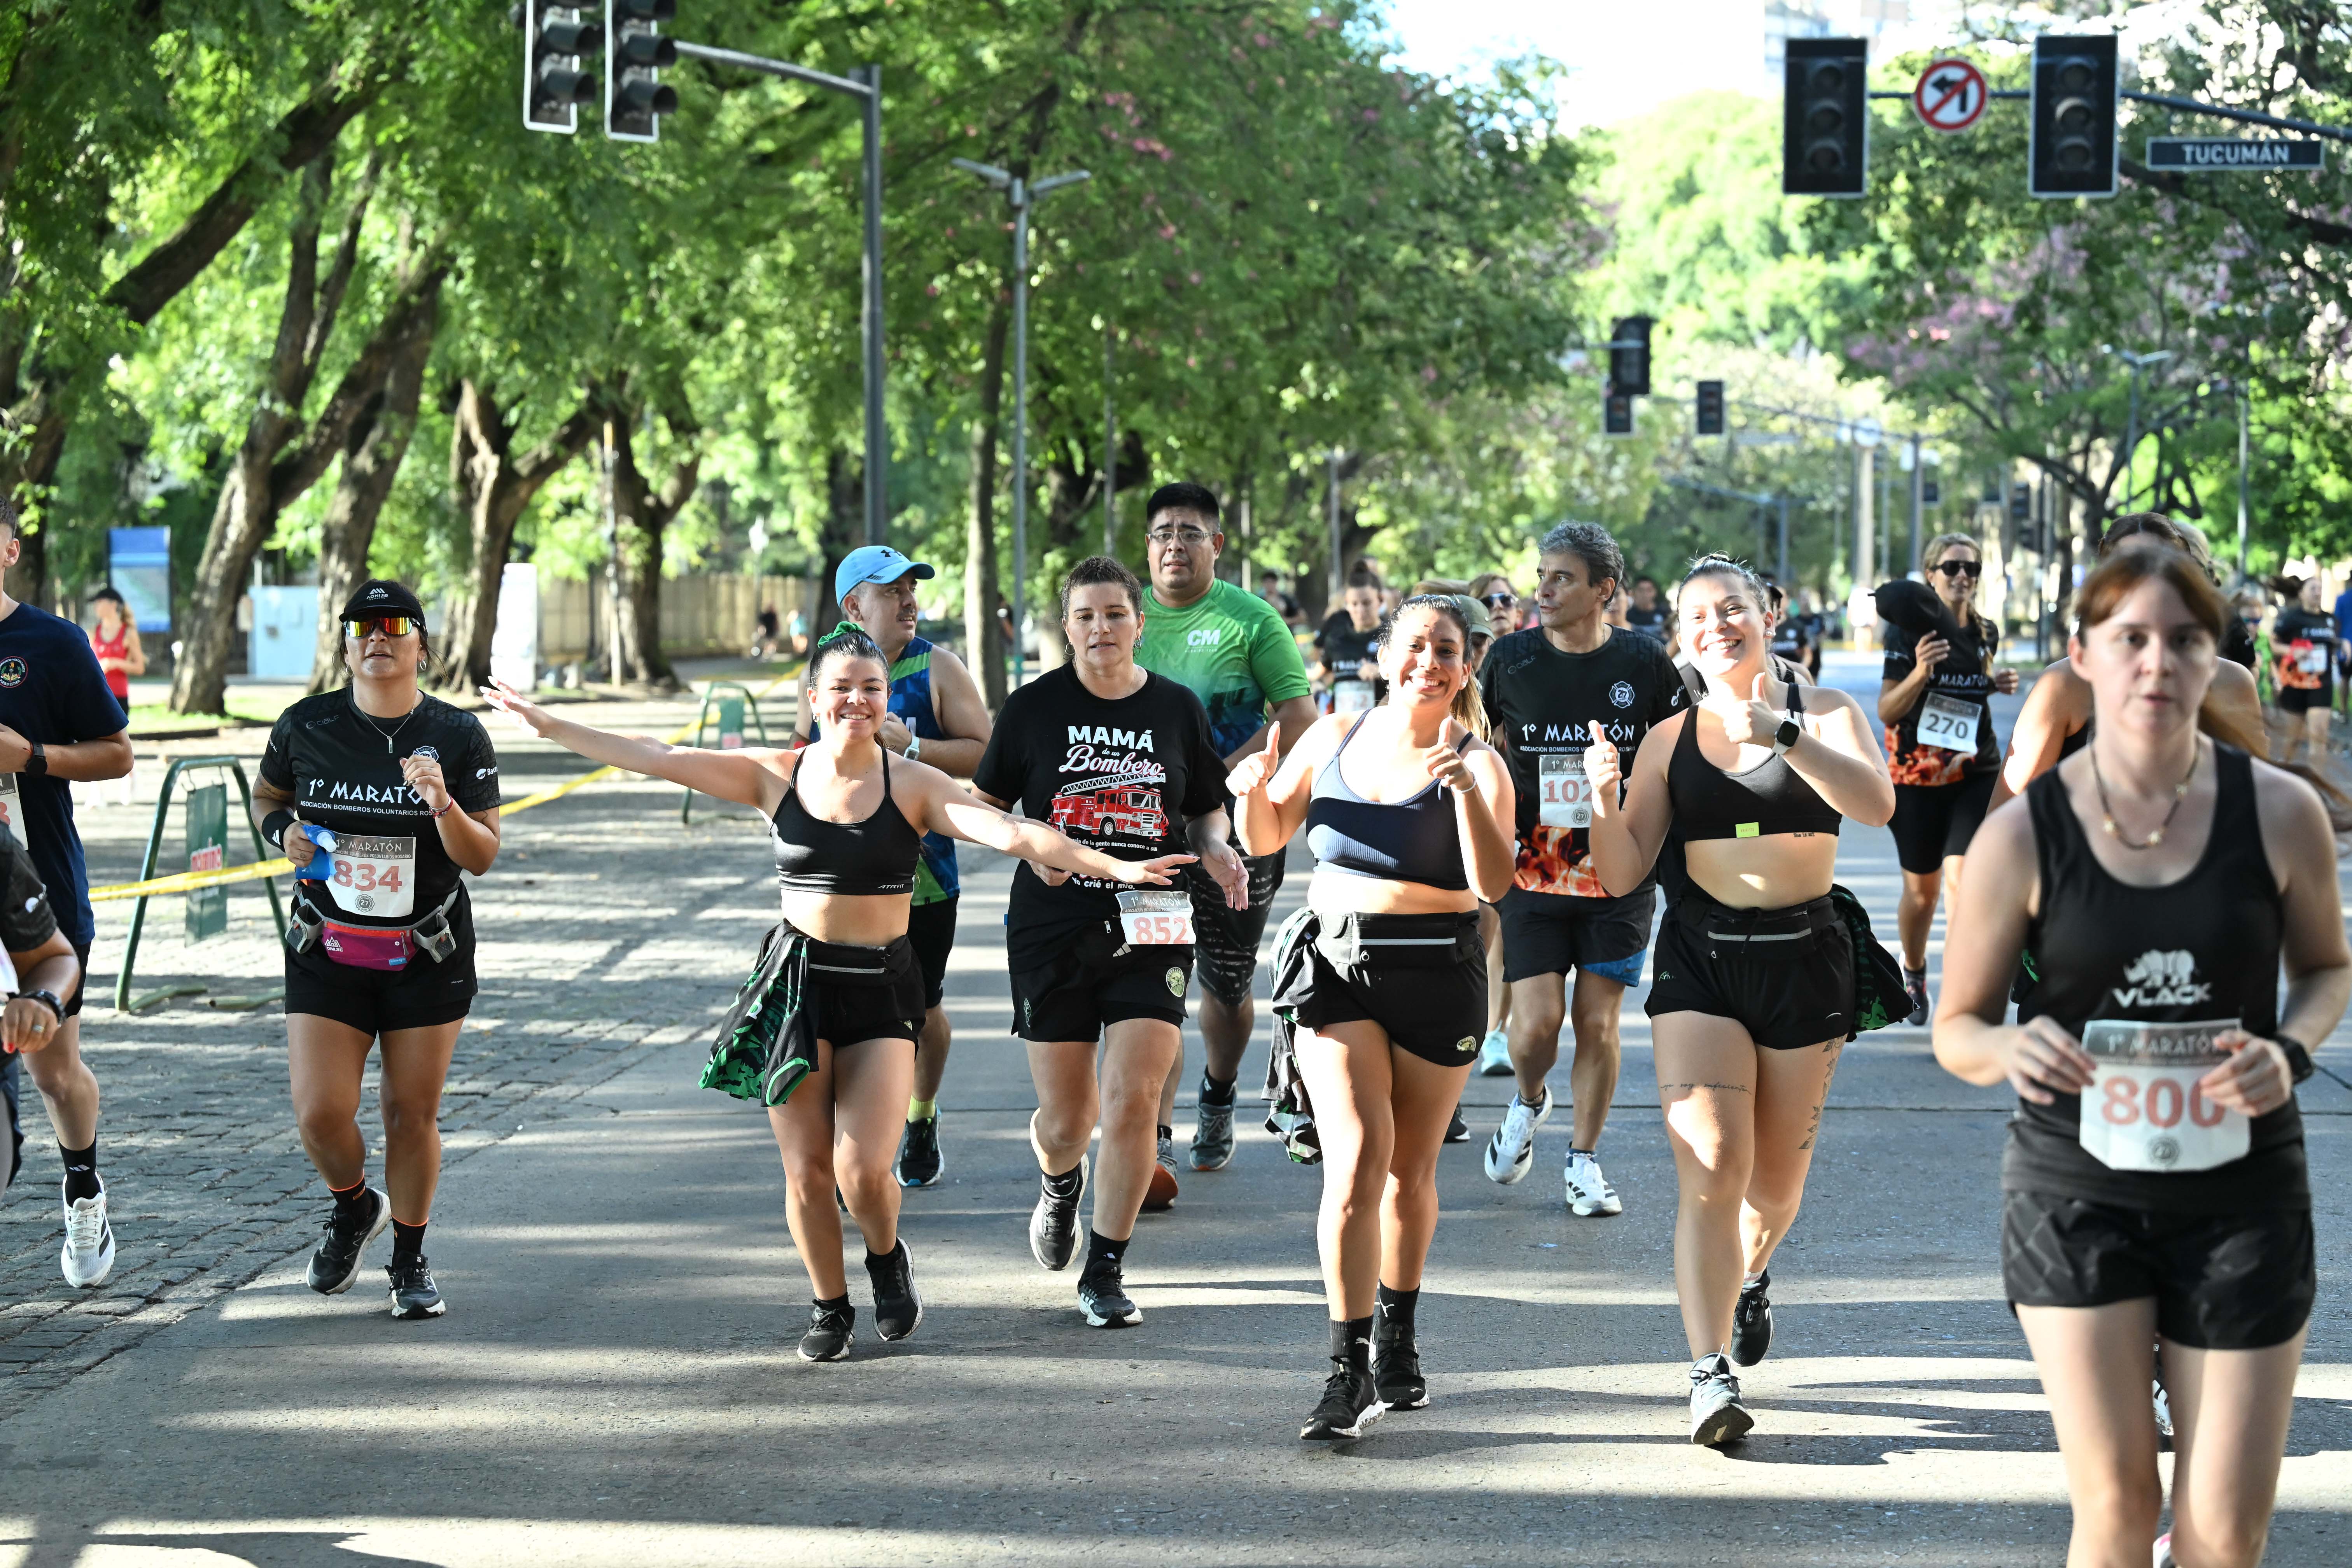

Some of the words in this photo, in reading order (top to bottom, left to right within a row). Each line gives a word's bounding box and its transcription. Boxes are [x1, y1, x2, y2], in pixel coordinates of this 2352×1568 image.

[2181, 142, 2290, 164] TUCUMÁN
[1187, 629, 1221, 646] CM
[1926, 713, 1969, 739] 270
[1068, 726, 1154, 753] MAMÁ
[1058, 744, 1164, 776] Bombero
[1544, 779, 1592, 803] 102
[300, 800, 332, 809] ASOCIACIÓN
[334, 804, 371, 813] BOMBEROS
[373, 808, 418, 816] VOLUNTARIOS
[349, 840, 402, 852] MARATÓN
[334, 860, 402, 892] 834
[1072, 877, 1081, 886] Yo
[1084, 879, 1101, 888] crié
[1142, 894, 1181, 906] MARATÓN
[1133, 917, 1188, 944] 852
[2112, 982, 2212, 1008] VLACK
[2101, 1075, 2225, 1128] 800
